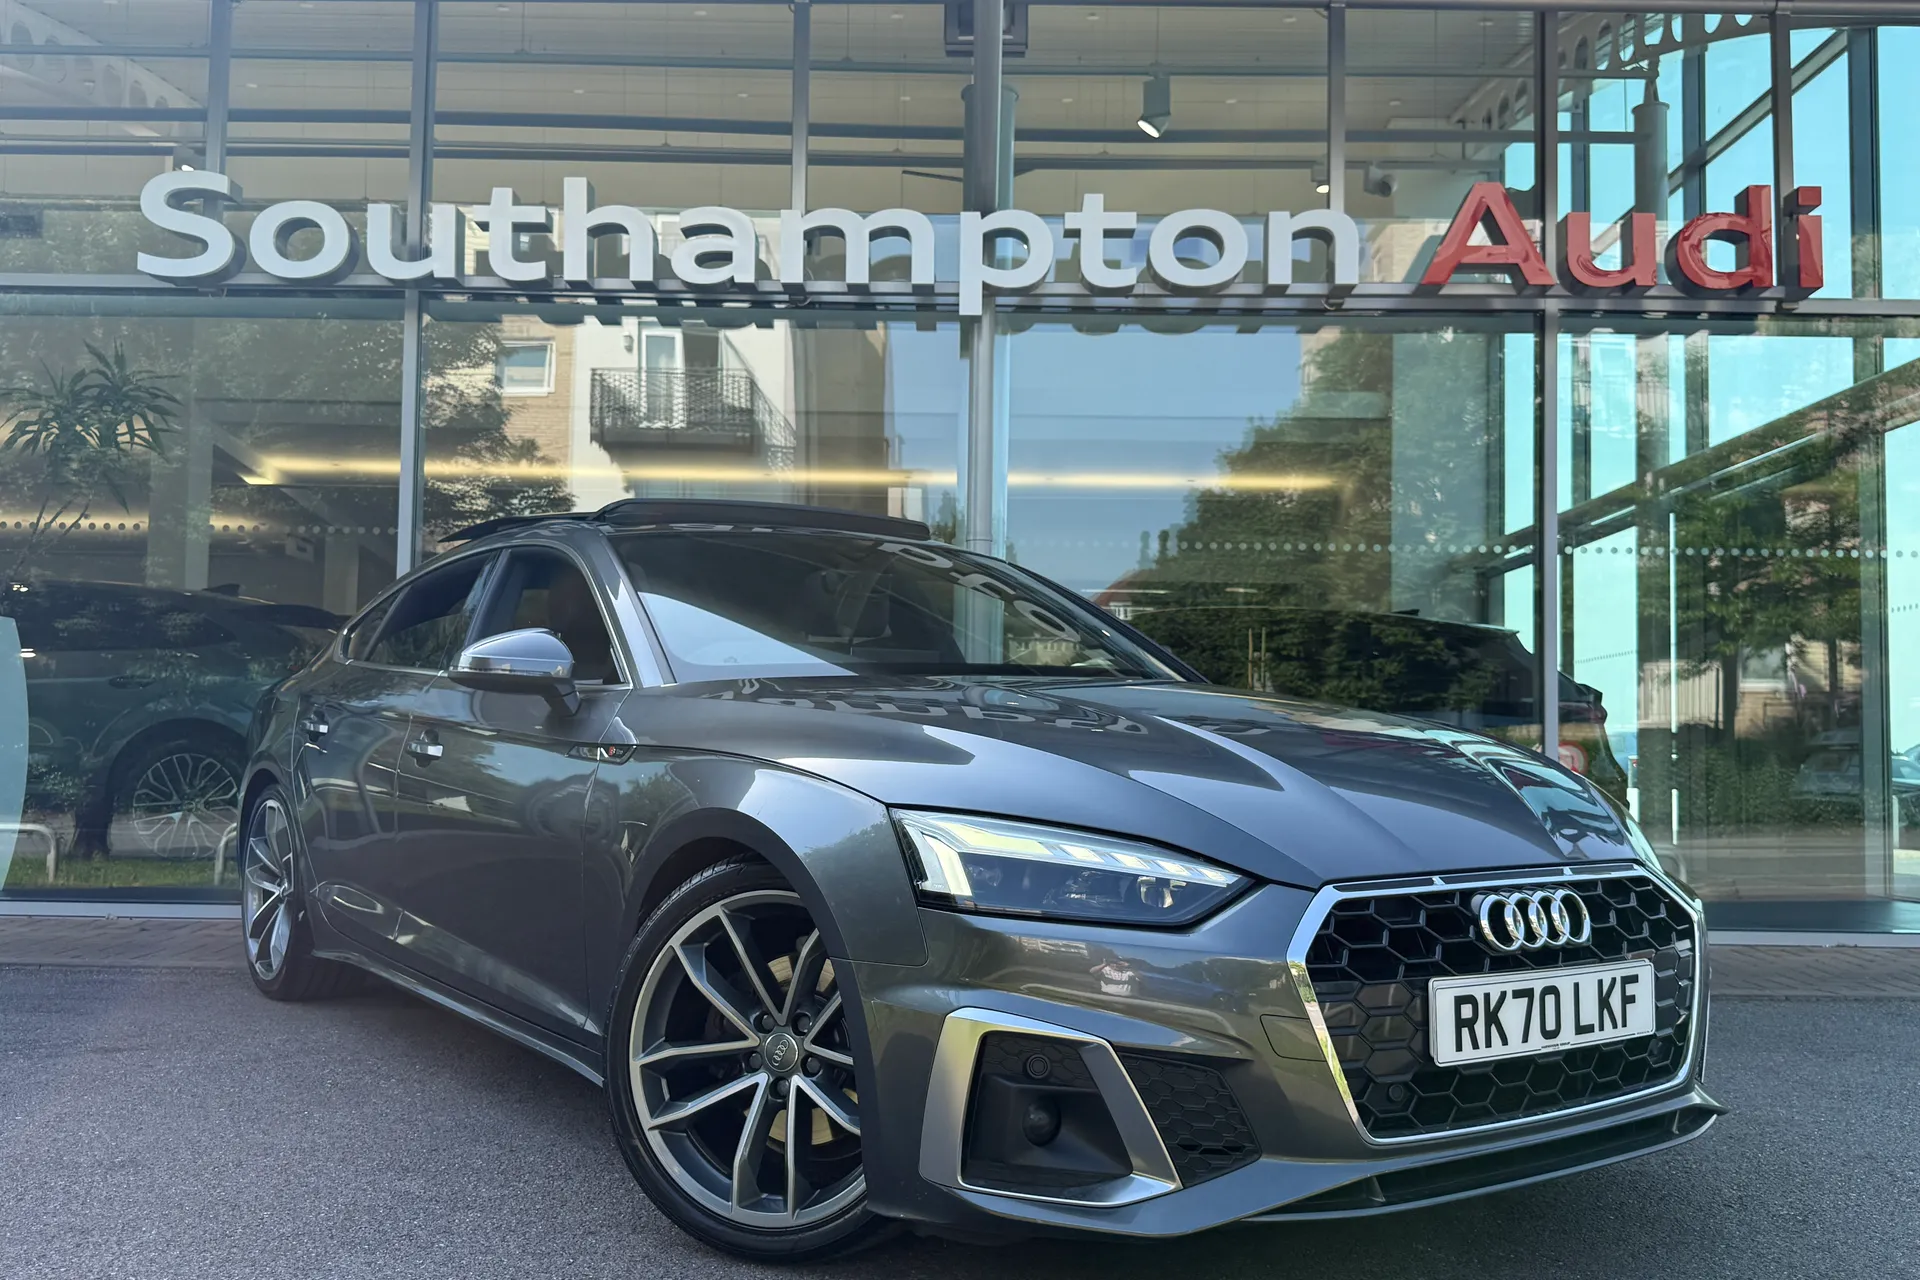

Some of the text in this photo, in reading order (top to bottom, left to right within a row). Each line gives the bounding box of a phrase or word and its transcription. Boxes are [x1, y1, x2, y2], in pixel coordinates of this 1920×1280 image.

[137, 170, 1824, 316] Southampton Audi
[1453, 973, 1640, 1053] RK70 LKF
